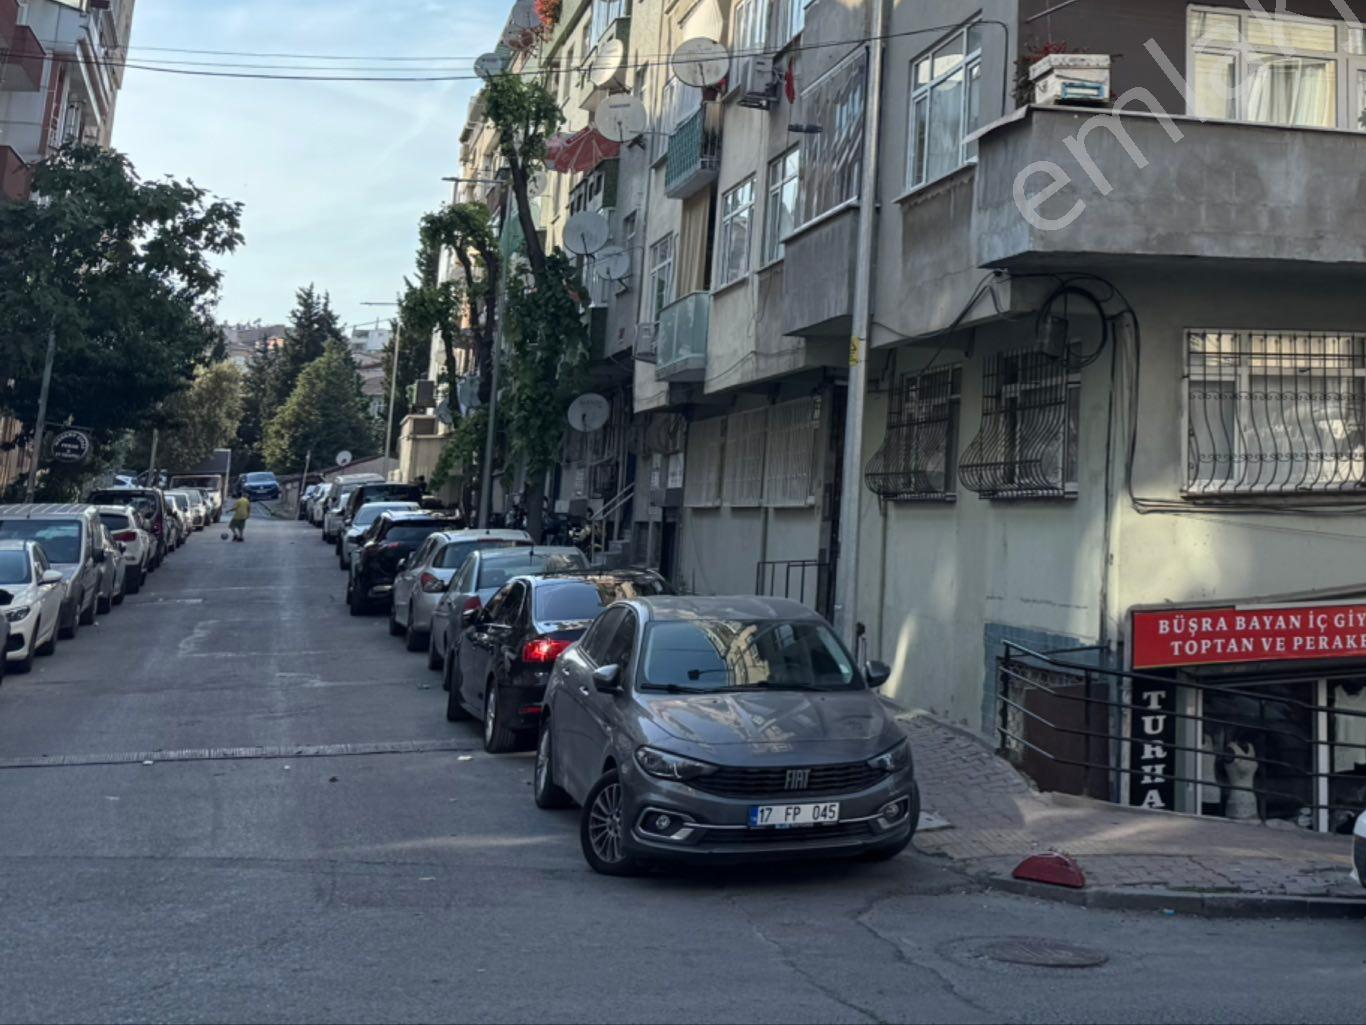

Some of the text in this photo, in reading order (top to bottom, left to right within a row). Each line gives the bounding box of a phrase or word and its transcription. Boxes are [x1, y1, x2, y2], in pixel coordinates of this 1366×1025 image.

[1158, 615, 1229, 637] BÜŞRA
[1235, 615, 1302, 631] BAYAN
[1308, 610, 1328, 633] İÇ
[1170, 637, 1254, 656] TOPTAN
[1261, 637, 1286, 652] VE
[784, 769, 811, 790] FIAT
[759, 804, 837, 823] 17 FP 045
